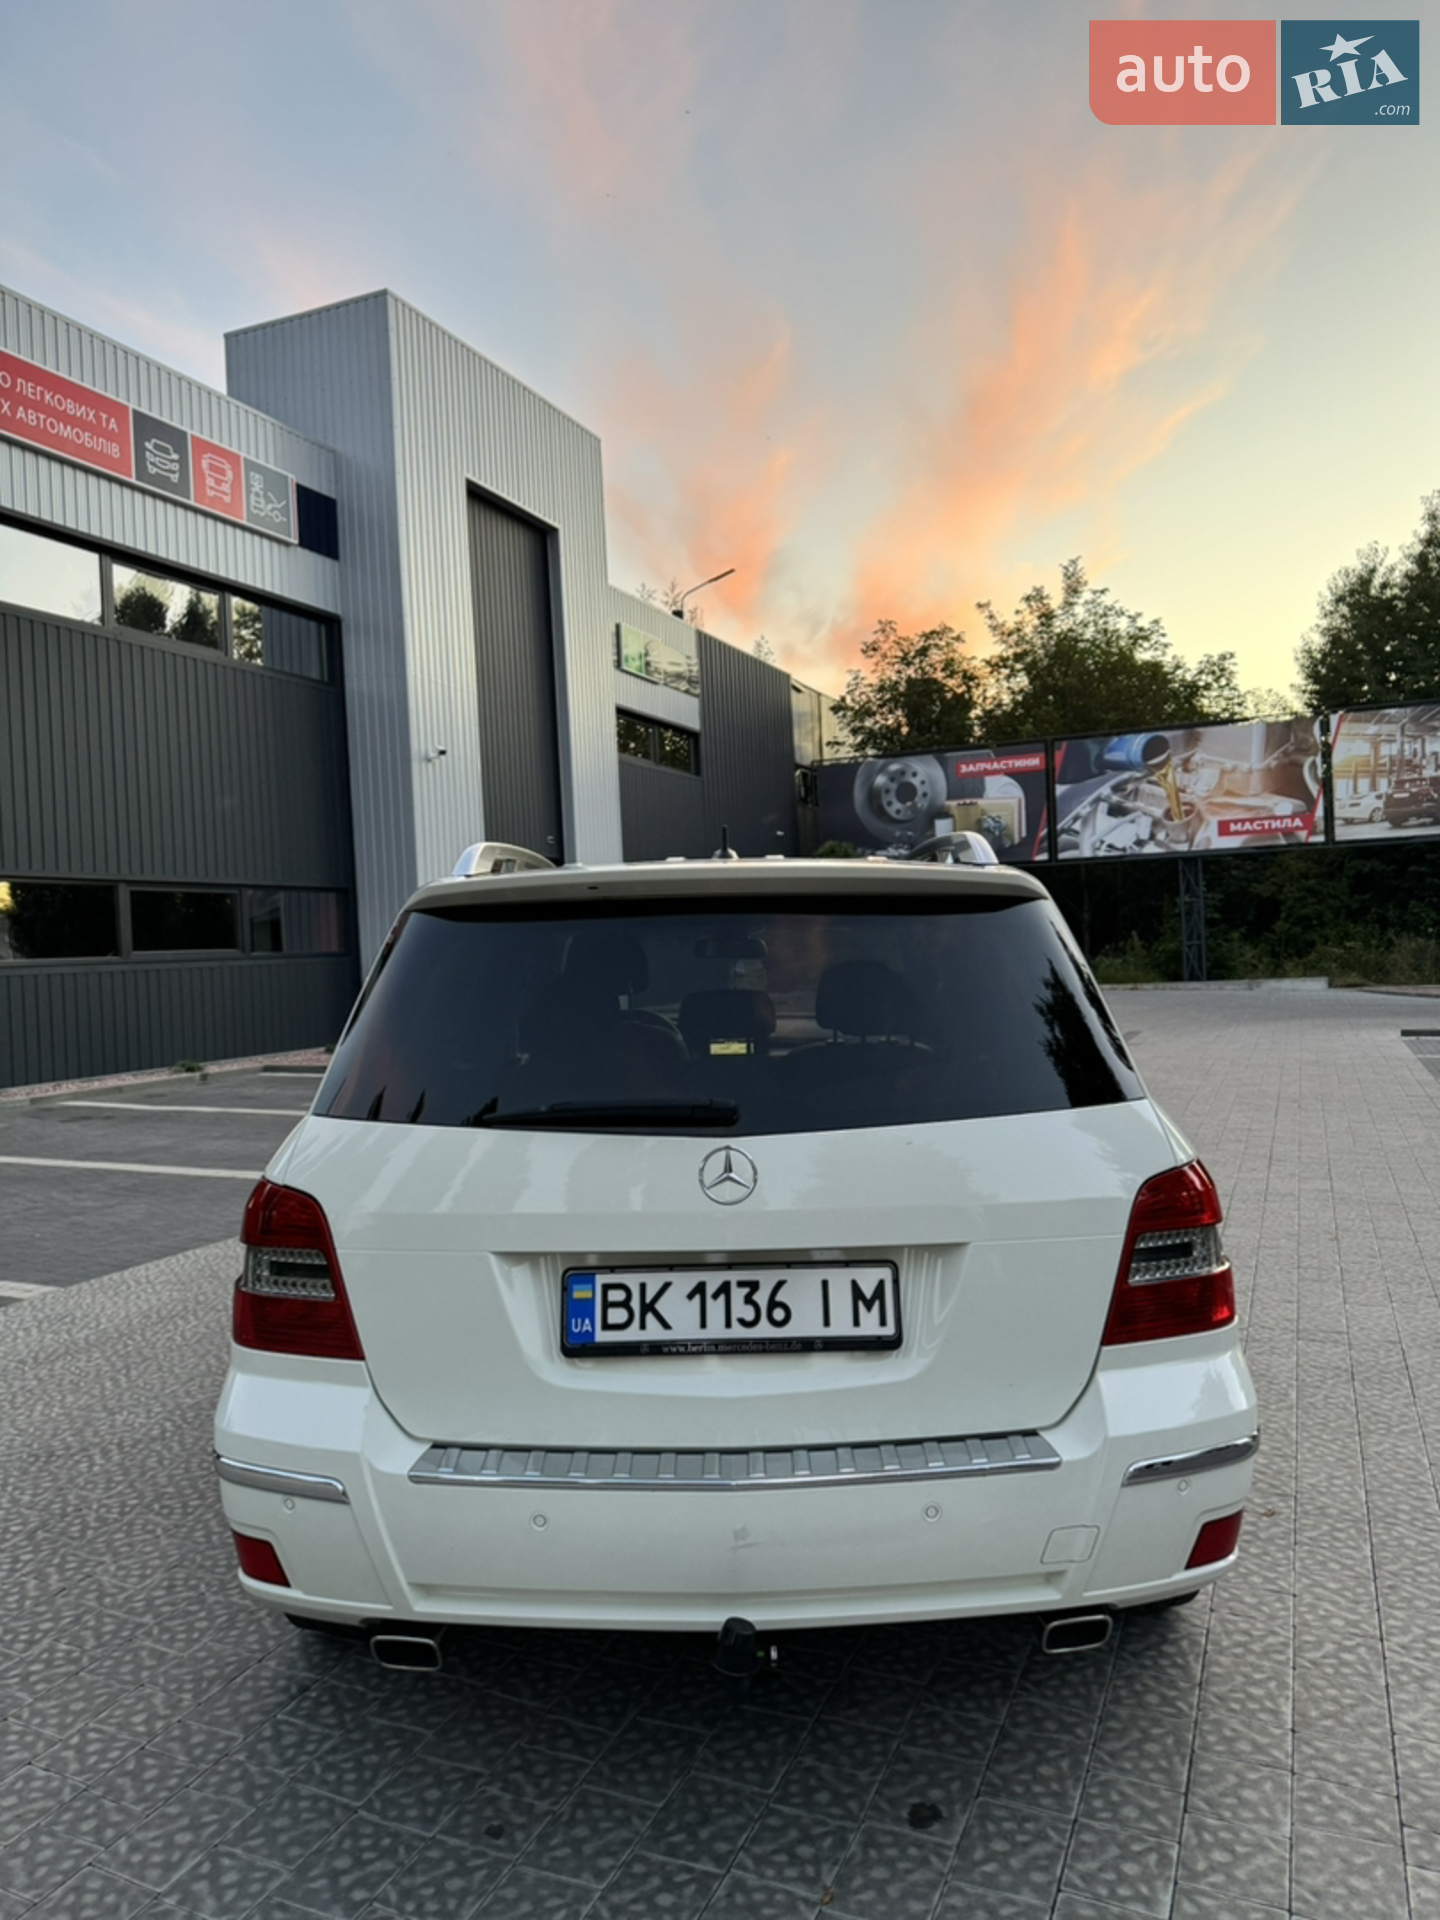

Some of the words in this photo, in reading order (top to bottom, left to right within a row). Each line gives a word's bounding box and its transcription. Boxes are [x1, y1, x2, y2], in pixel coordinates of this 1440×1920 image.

[16, 377, 96, 424] ЛЕГКОВИХ
[99, 411, 119, 433] ТА
[16, 404, 121, 459] АВТОМОБІЛІВ
[960, 757, 1040, 773] ЗАПЧАСТИНИ
[1229, 817, 1304, 832] МАСТИЛА
[601, 1282, 673, 1331] BK
[686, 1280, 792, 1330] 1136
[571, 1318, 593, 1334] UA
